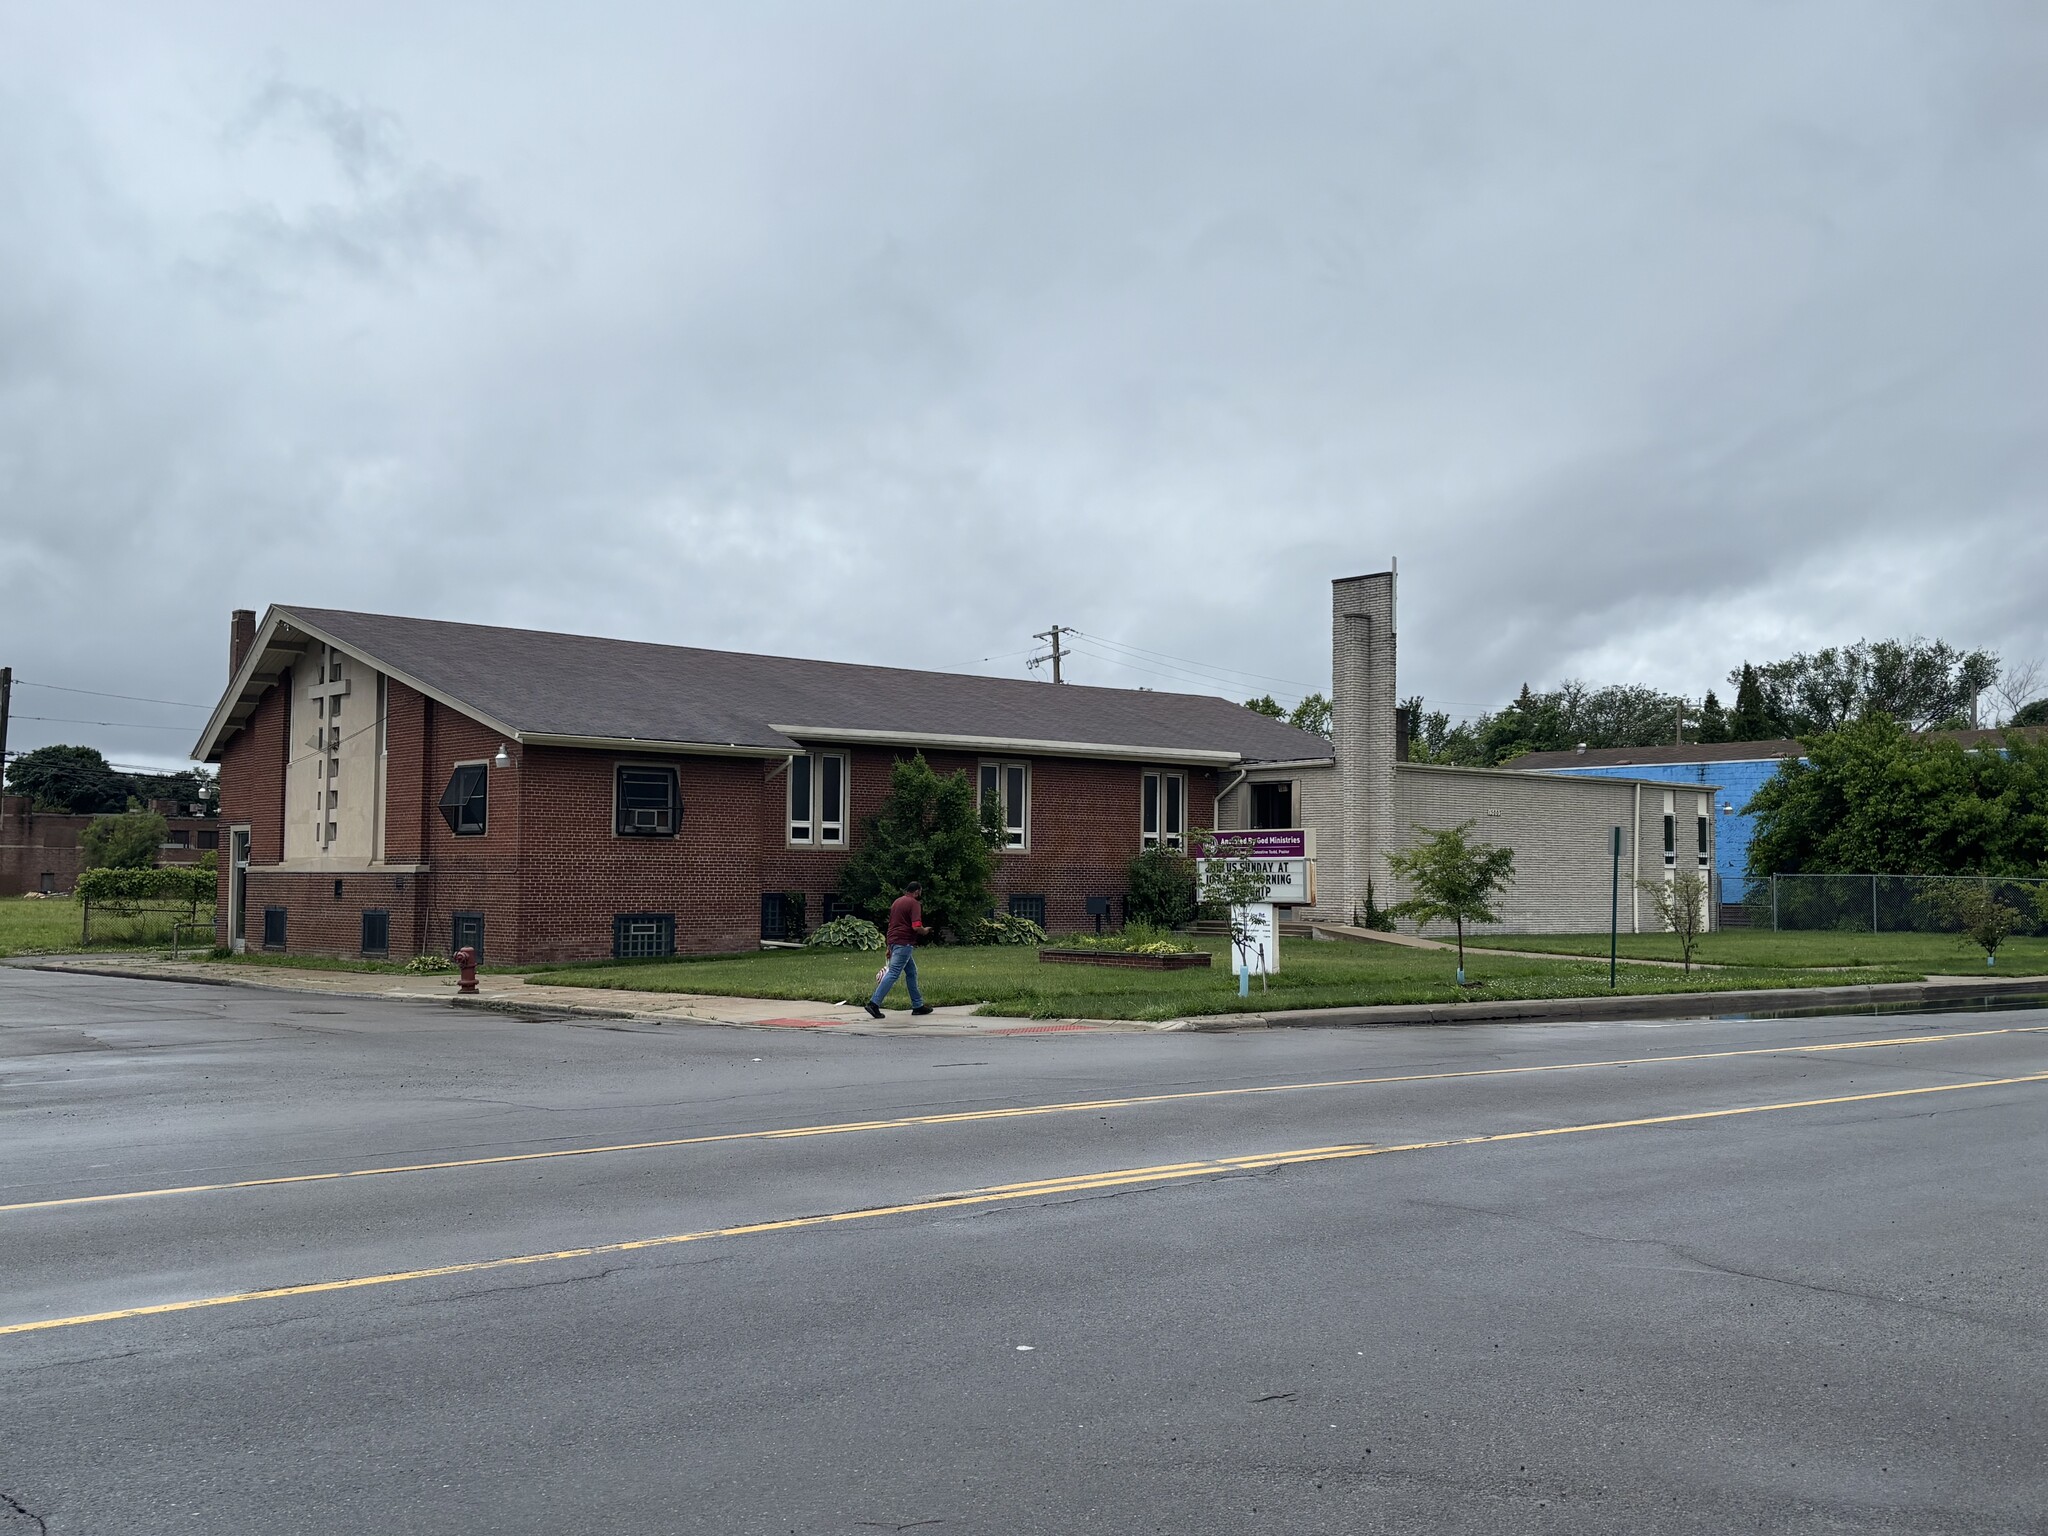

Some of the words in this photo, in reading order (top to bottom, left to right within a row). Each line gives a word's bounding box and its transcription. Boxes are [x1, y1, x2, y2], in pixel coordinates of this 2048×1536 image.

[1257, 836, 1269, 844] God
[1269, 836, 1301, 844] Ministries
[1226, 862, 1237, 873] US
[1239, 862, 1274, 873] SUNDAY
[1277, 862, 1289, 873] AT
